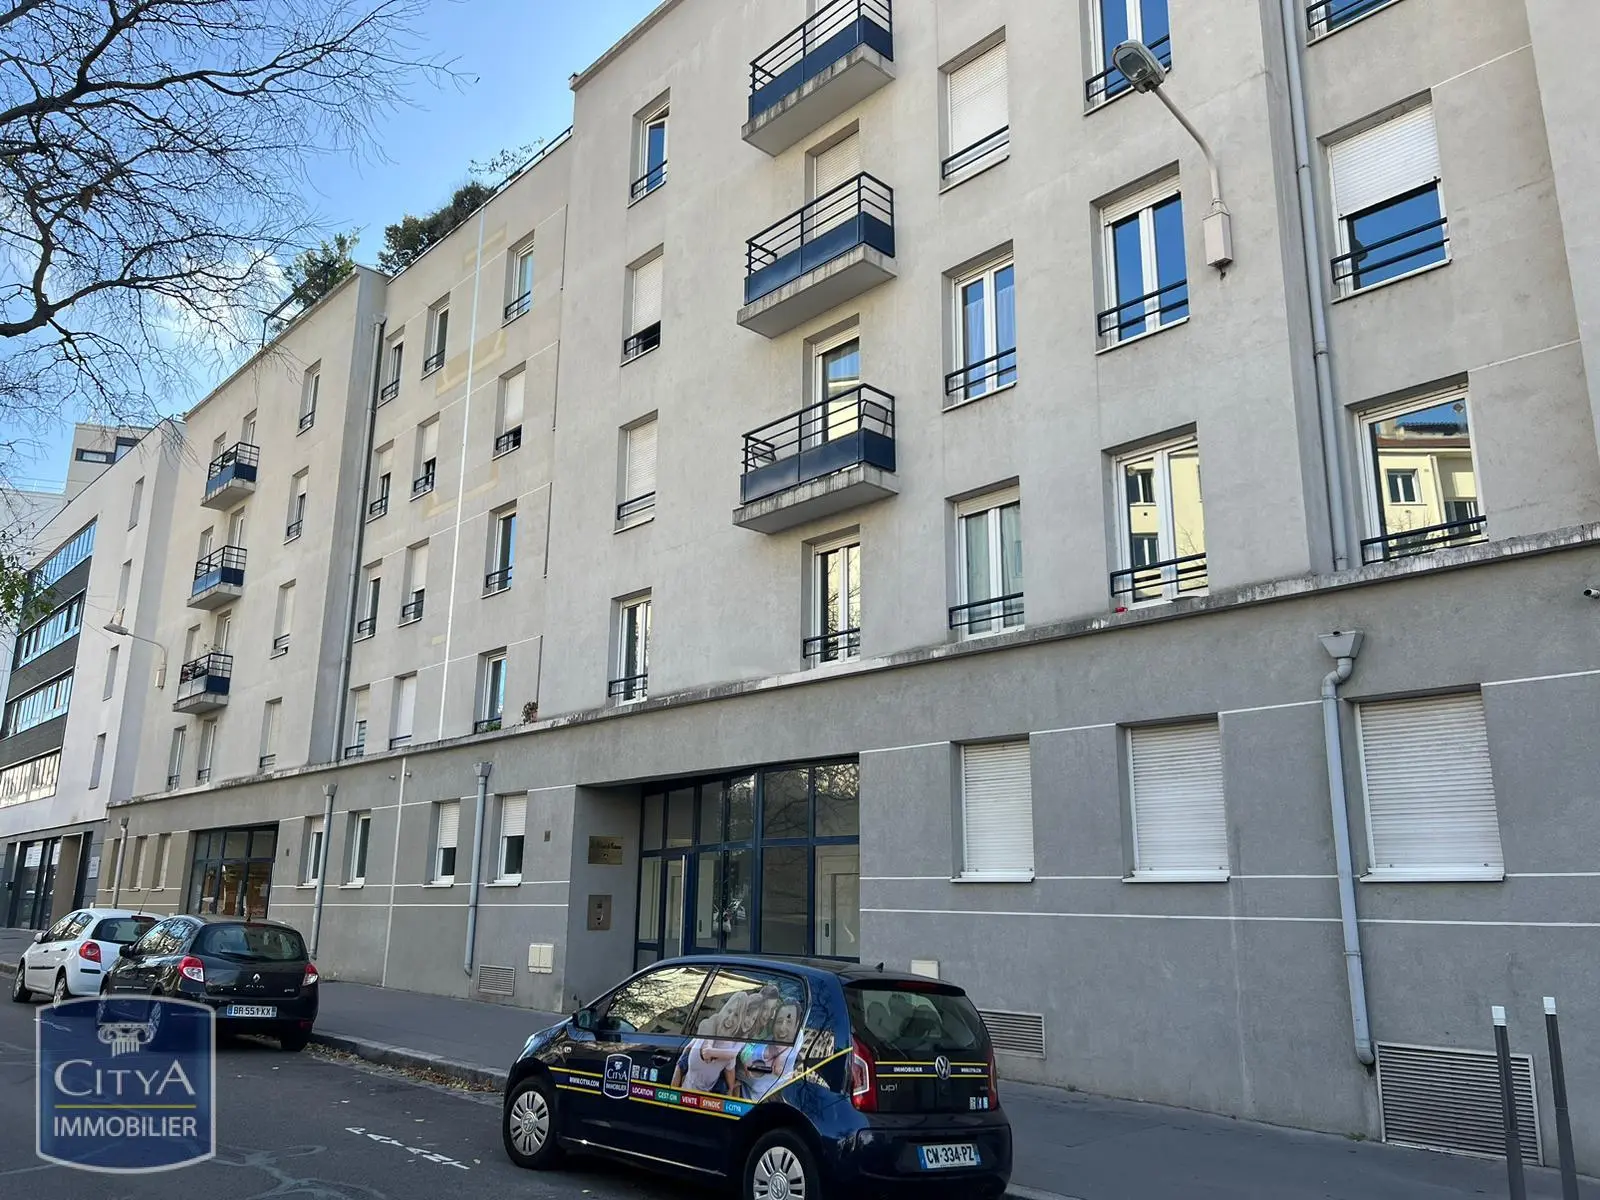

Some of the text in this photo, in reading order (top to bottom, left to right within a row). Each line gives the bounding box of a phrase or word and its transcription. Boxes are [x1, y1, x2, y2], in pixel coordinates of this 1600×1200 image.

[632, 1087, 654, 1097] LOCATION
[658, 1091, 677, 1101] GESTON
[682, 1095, 697, 1105] VENTE
[702, 1099, 720, 1109] SYNDIC
